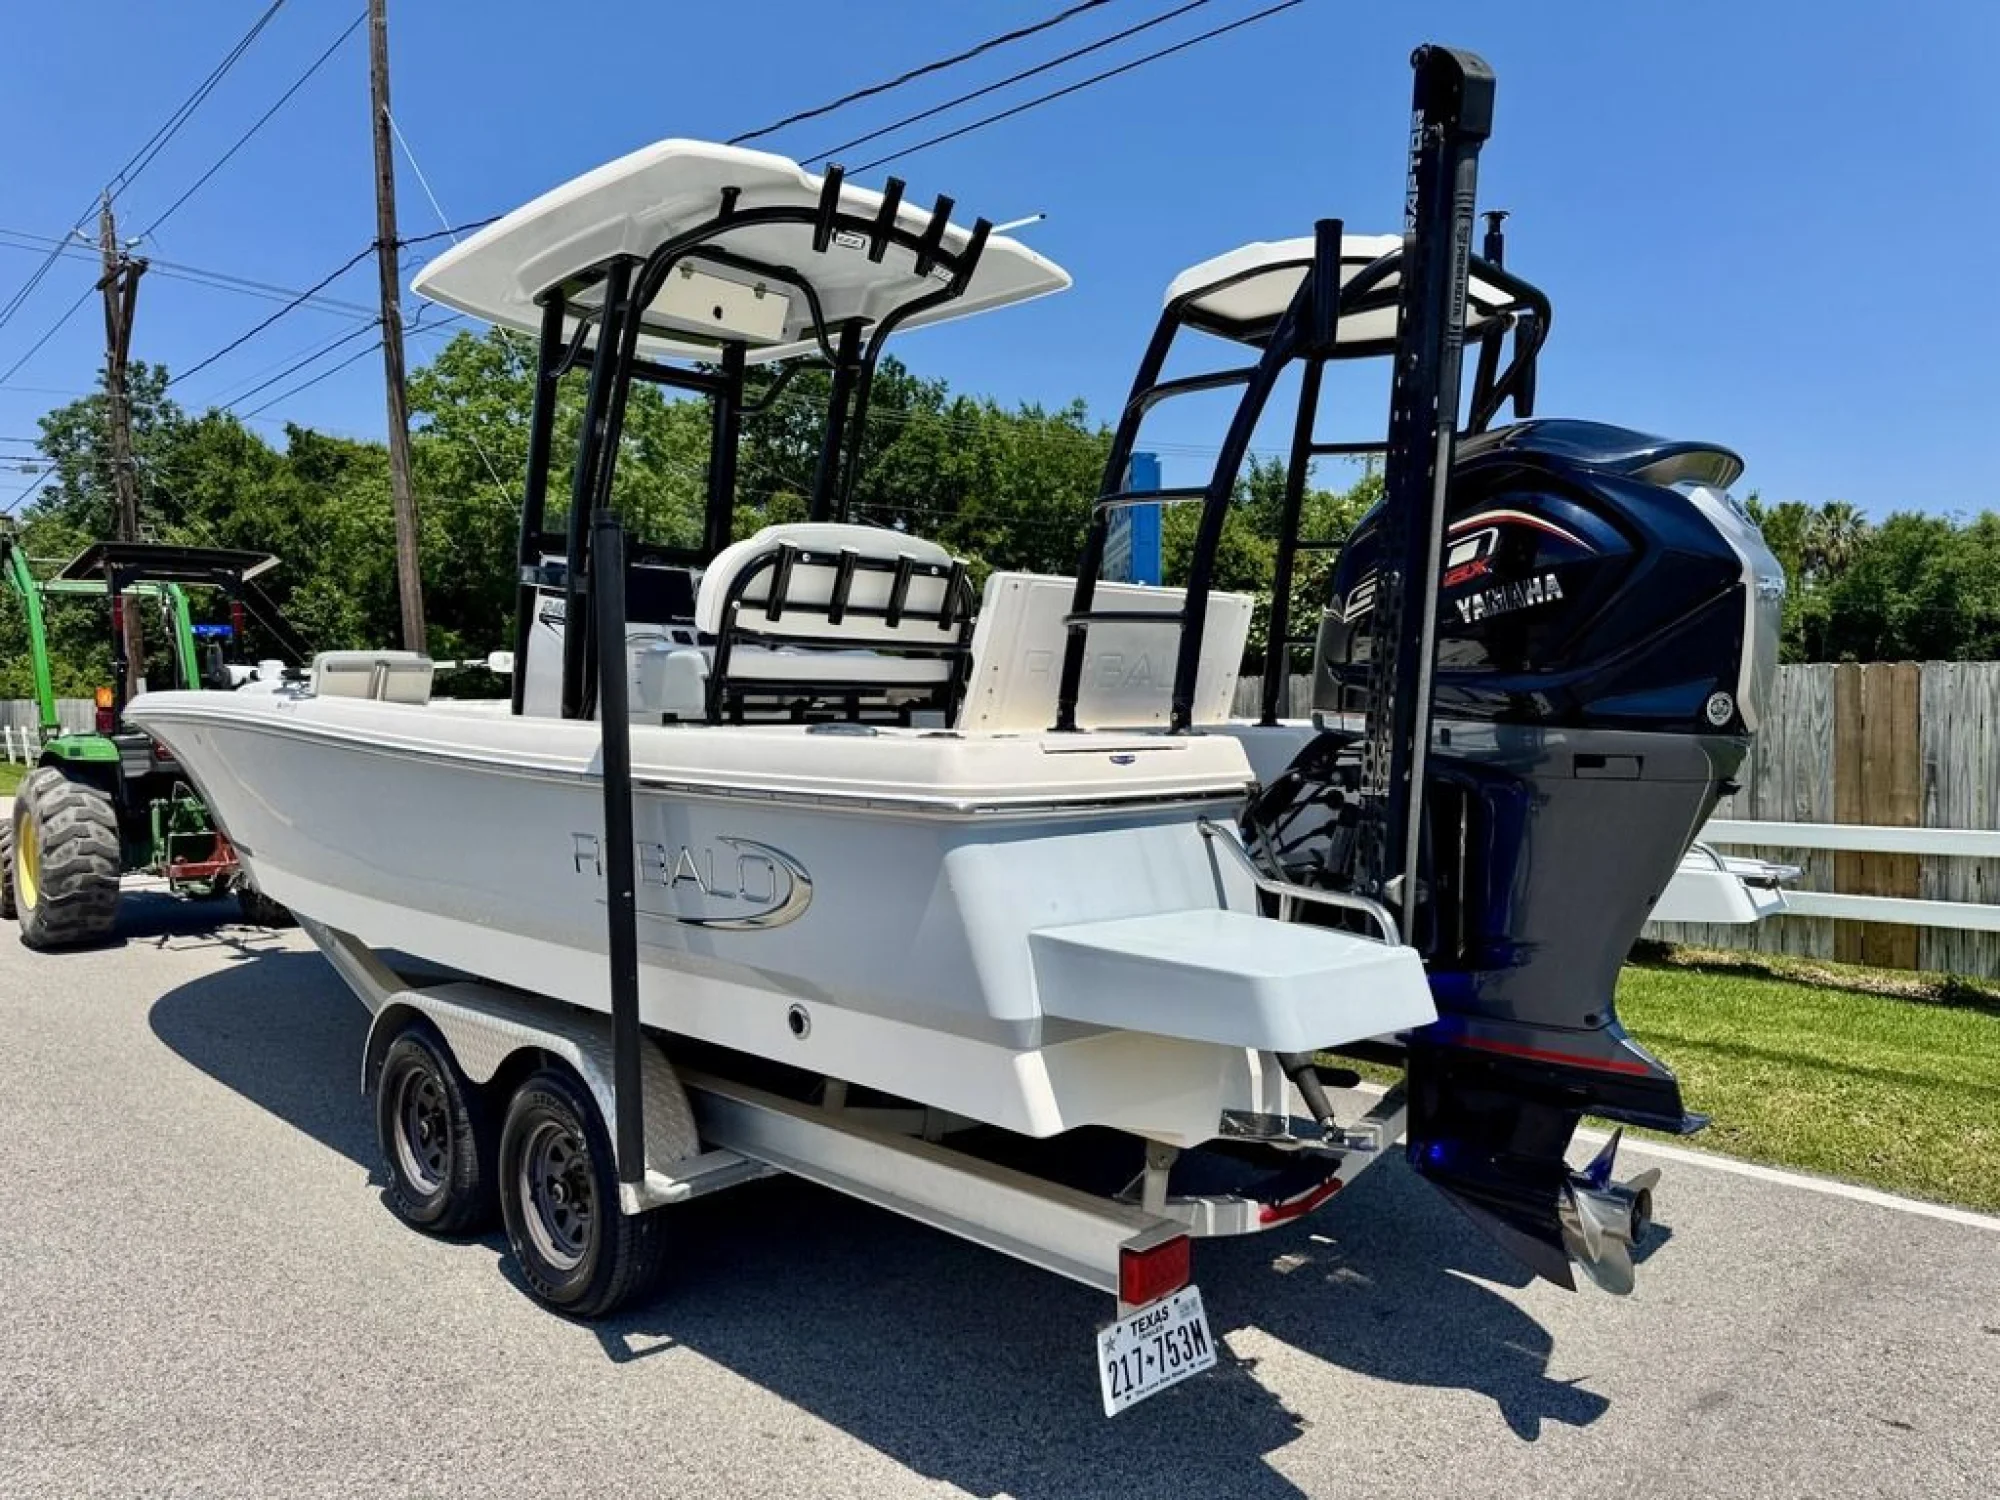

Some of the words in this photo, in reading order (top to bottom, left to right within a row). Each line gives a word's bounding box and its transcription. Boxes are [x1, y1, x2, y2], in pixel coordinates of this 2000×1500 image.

[1404, 108, 1425, 233] RAPTOR
[1455, 573, 1563, 624] YAMAHA
[571, 832, 775, 904] RBALO
[1130, 1305, 1169, 1337] TEXAS
